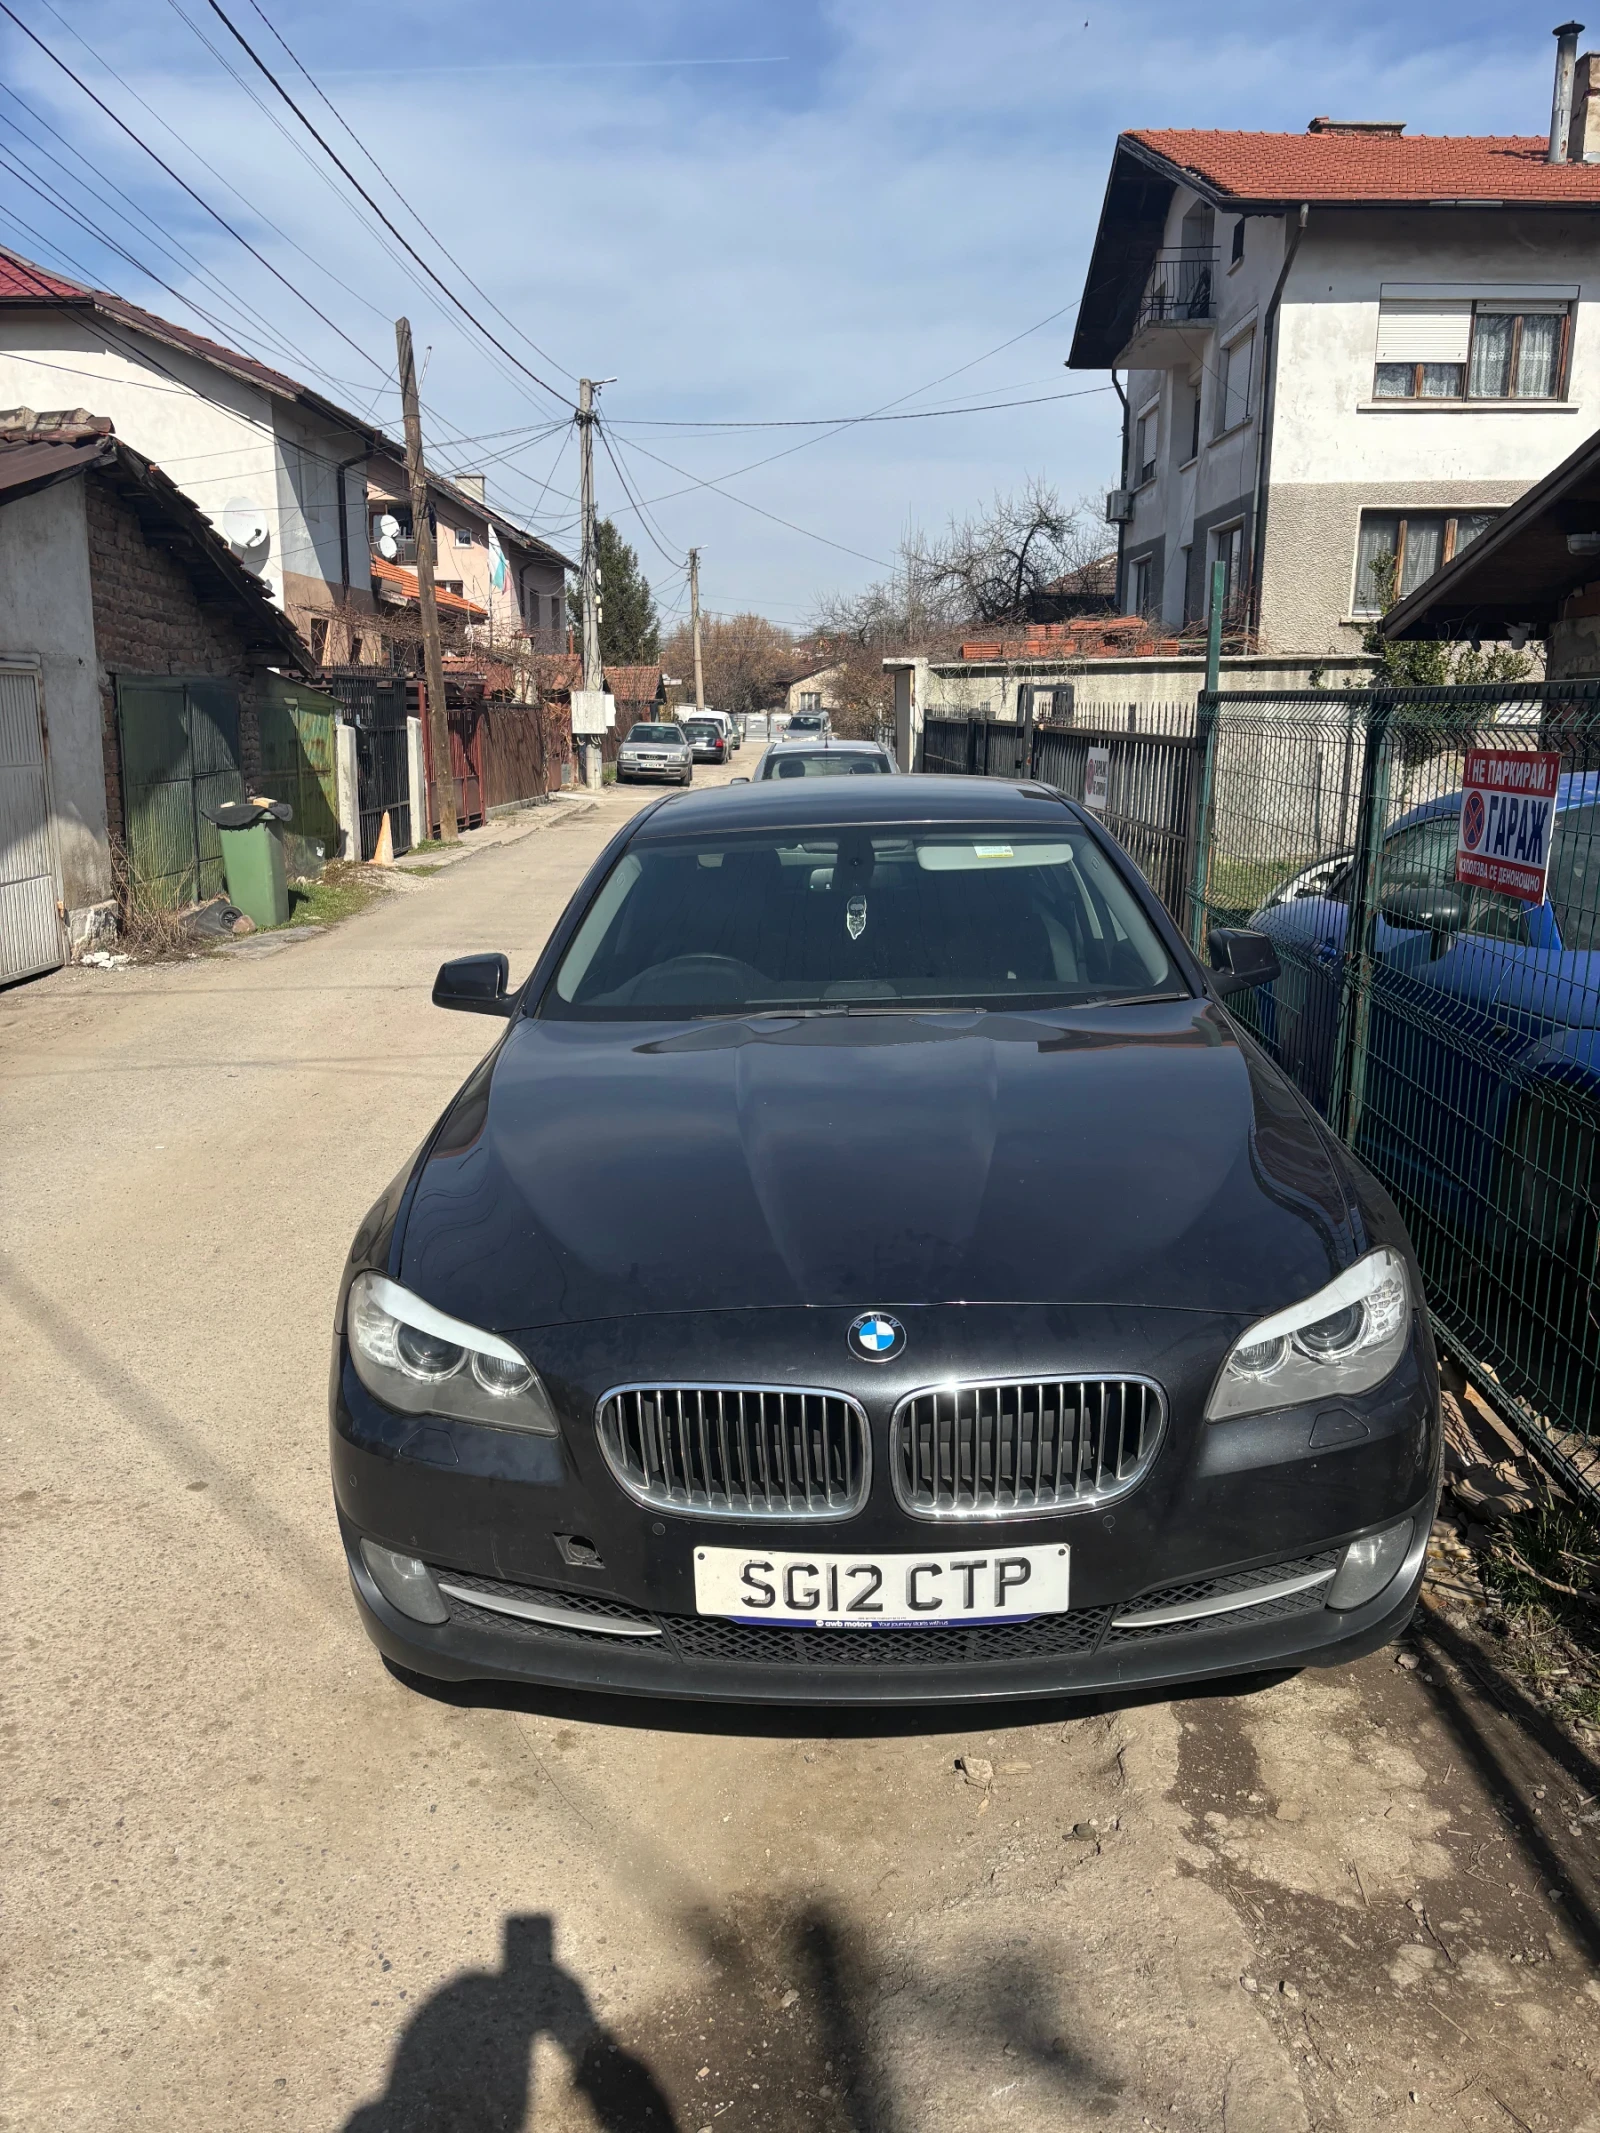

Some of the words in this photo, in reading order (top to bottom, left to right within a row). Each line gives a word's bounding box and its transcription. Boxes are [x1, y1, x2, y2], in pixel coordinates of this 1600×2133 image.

[1472, 758, 1486, 783] НЕ
[1487, 757, 1547, 790] ПАРКИРАЙ
[1485, 795, 1549, 865] ГАРАЖ
[1489, 865, 1498, 881] СЕ
[1497, 867, 1541, 893] ДЕНОНОЩНО
[853, 1314, 900, 1330] BMW
[738, 1559, 884, 1612] SG12
[905, 1556, 1032, 1612] CTP
[844, 1620, 873, 1628] motors
